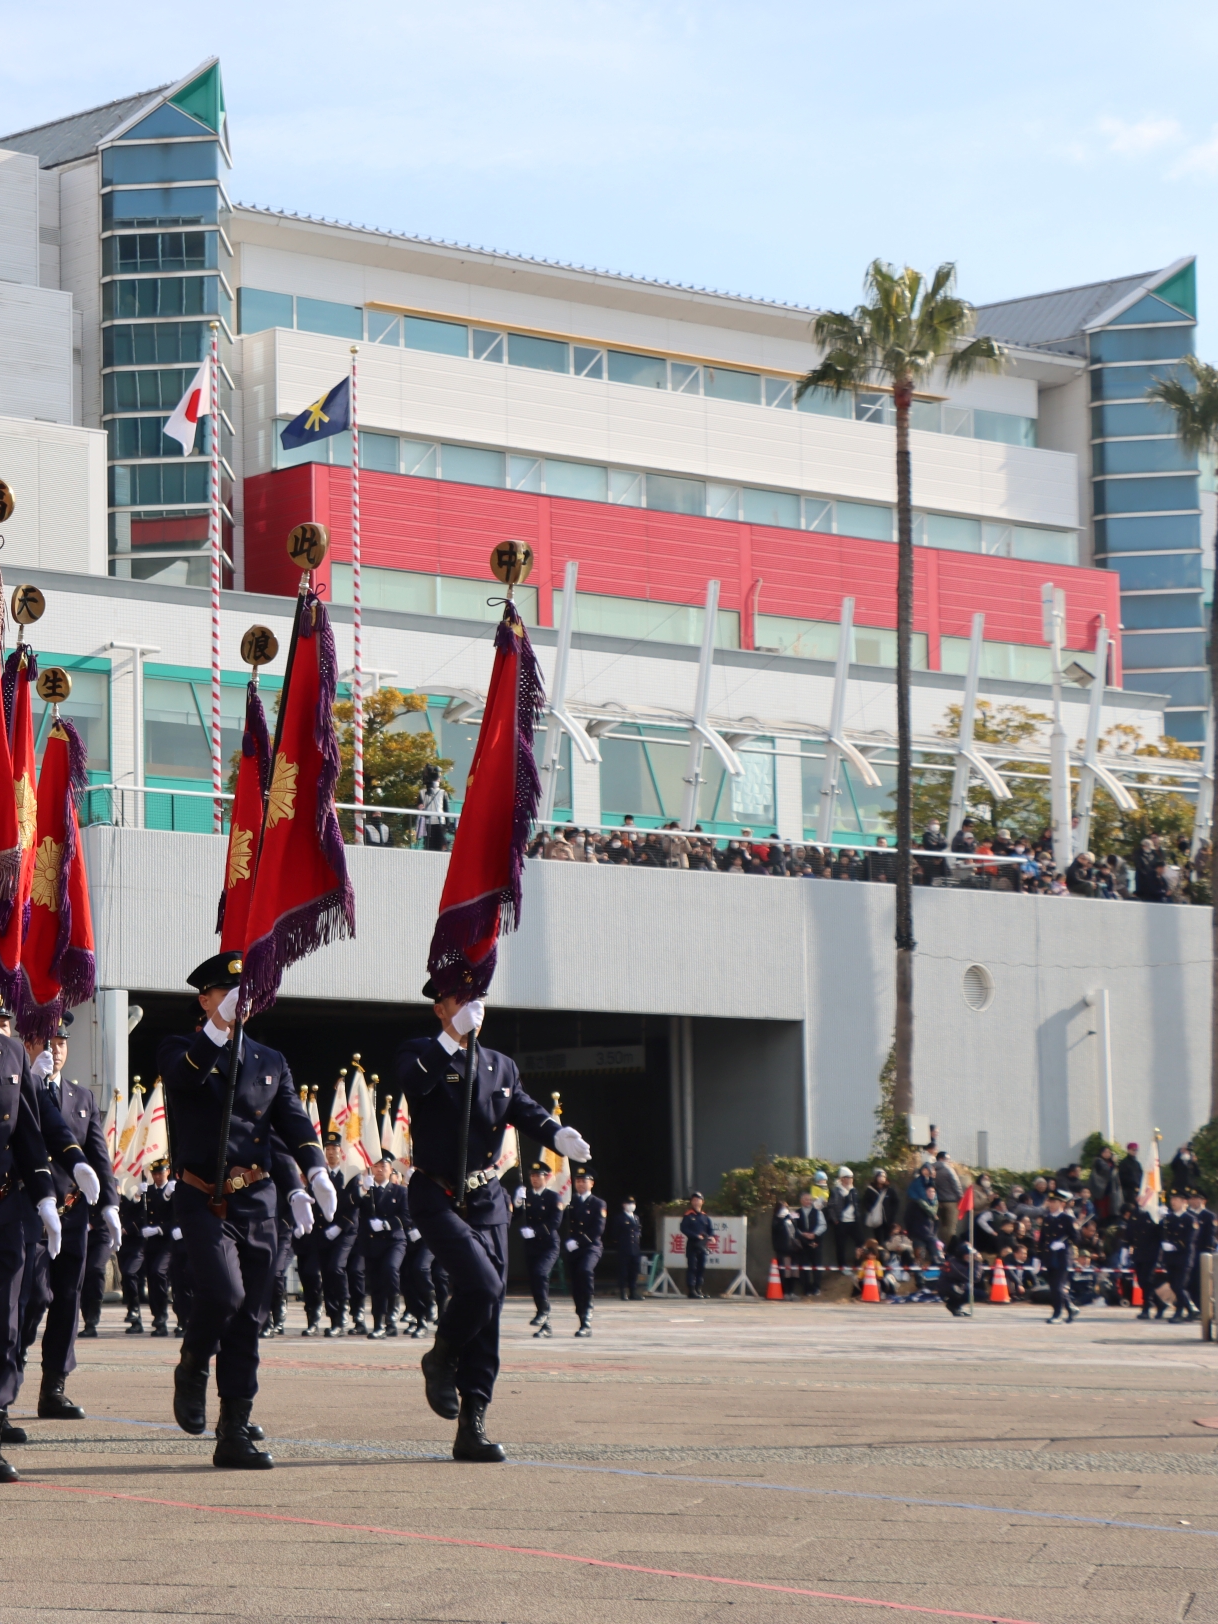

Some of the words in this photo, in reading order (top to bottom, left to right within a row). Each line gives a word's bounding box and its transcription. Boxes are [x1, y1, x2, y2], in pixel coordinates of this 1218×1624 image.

[290, 525, 318, 564] 此
[497, 542, 517, 583] 中
[17, 587, 39, 619] 天
[247, 630, 272, 661] 浪
[42, 670, 66, 698] 生
[595, 1050, 634, 1067] 3.50m
[669, 1233, 738, 1255] 進禁止
